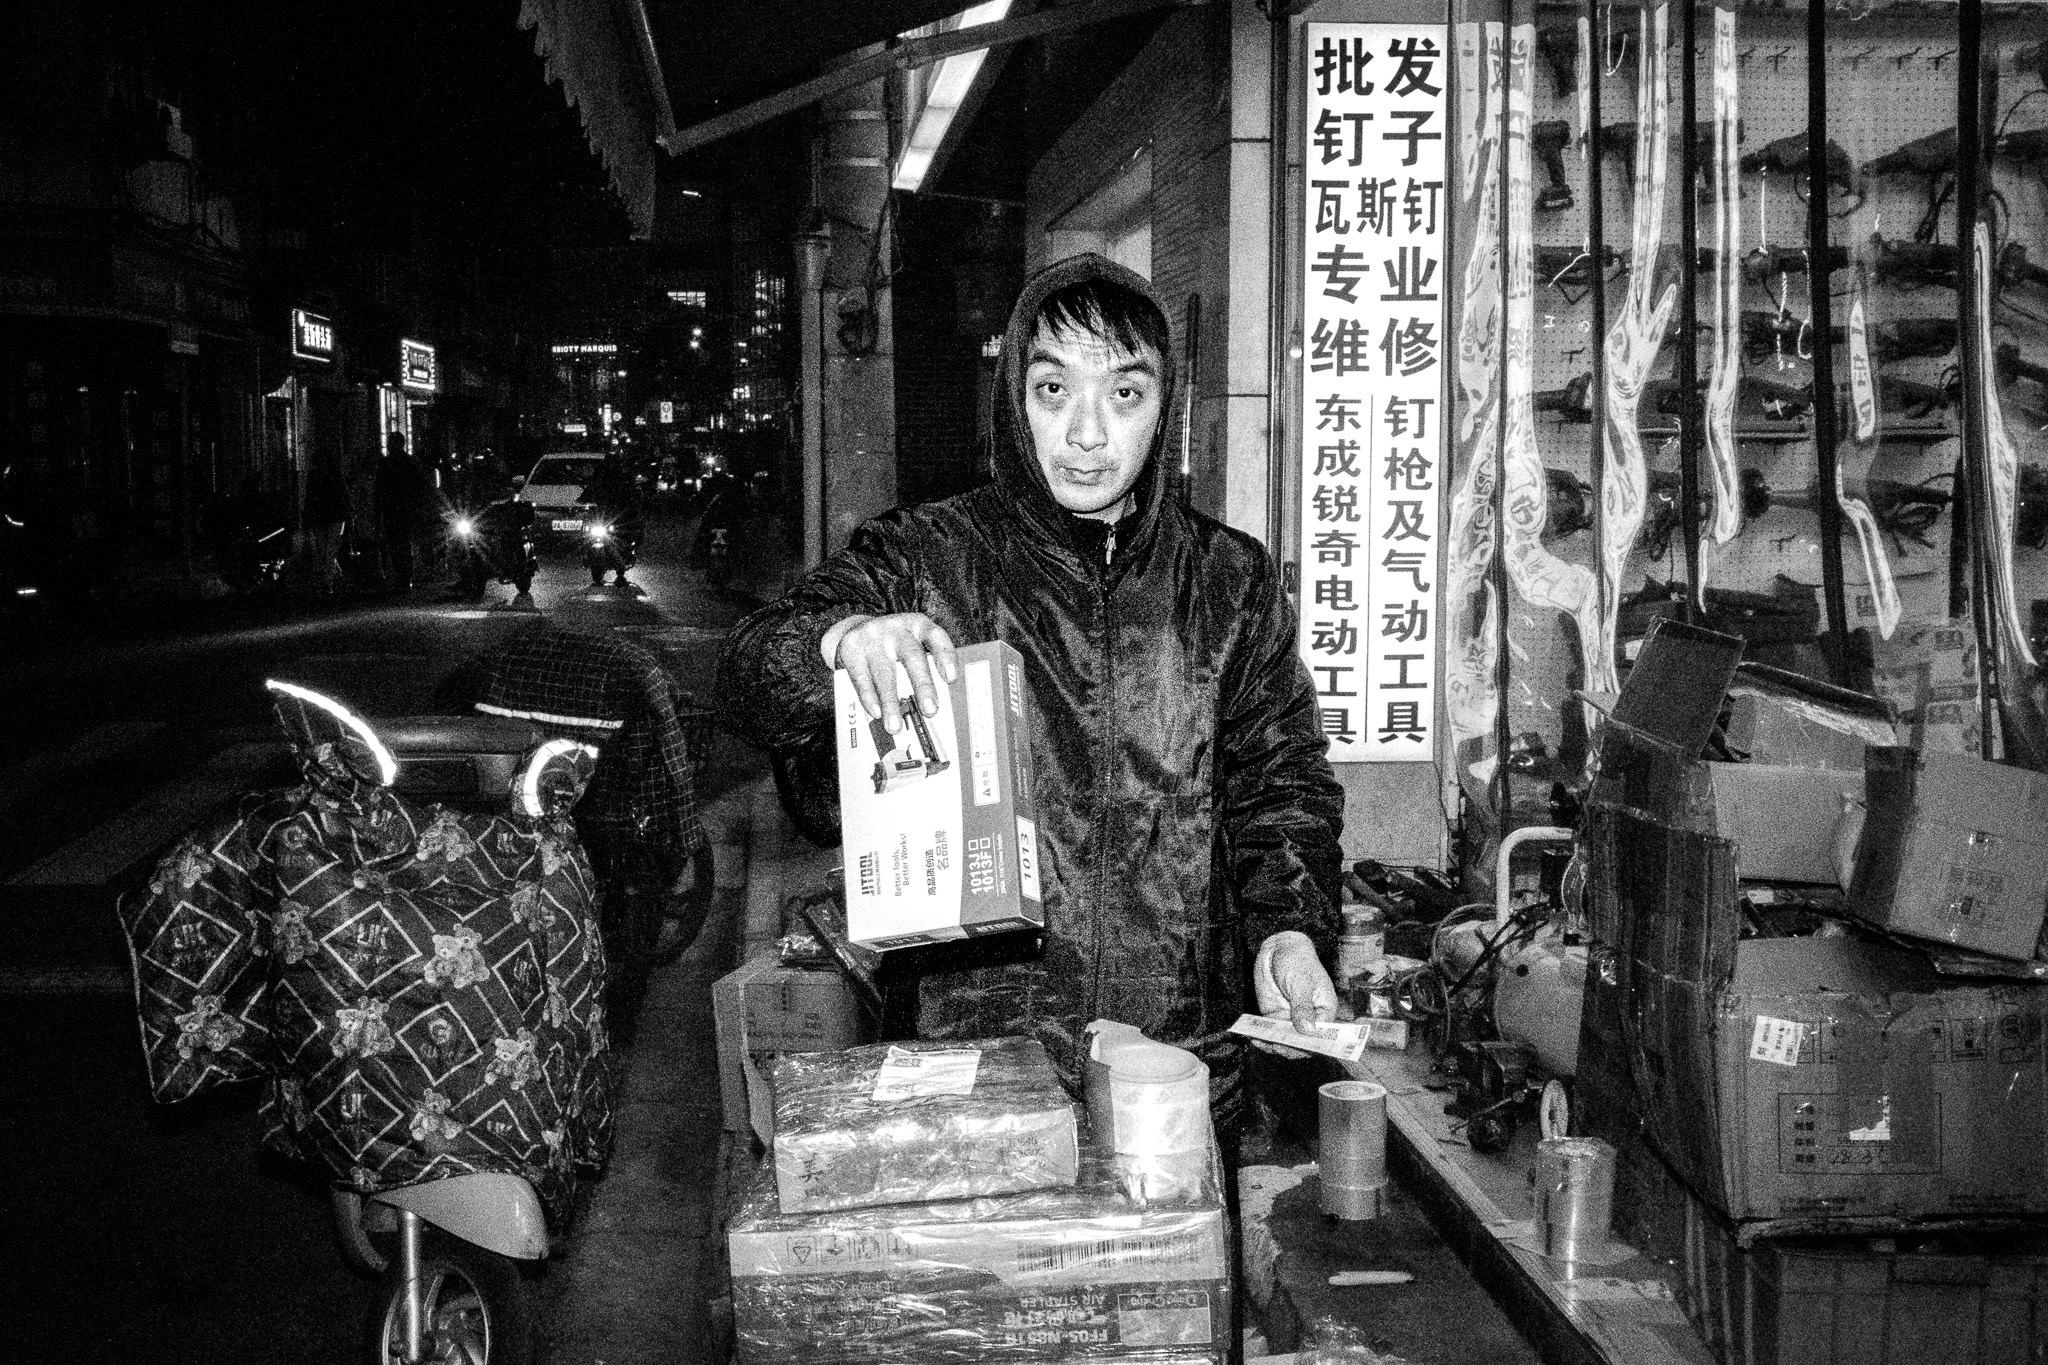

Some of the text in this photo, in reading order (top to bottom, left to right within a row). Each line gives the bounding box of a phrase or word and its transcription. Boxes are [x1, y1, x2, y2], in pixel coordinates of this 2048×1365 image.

[1314, 37, 1443, 98] 批发
[1313, 108, 1442, 167] 钉子
[1311, 177, 1443, 237] 瓦斯钉
[1311, 244, 1439, 305] 专业
[580, 344, 617, 353] MARQUIS
[1310, 317, 1439, 377] 维修
[1311, 394, 1362, 745] 东成锐奇电动工具
[1378, 395, 1435, 744] 钉枪及气动工具
[859, 852, 875, 896] JITOOL
[891, 849, 903, 897] Better Tools,
[899, 833, 910, 886] Better Works!
[934, 830, 950, 871] 名品牌
[1020, 833, 1032, 880] 1013
[1019, 1294, 1106, 1309] AIR STAPLER
